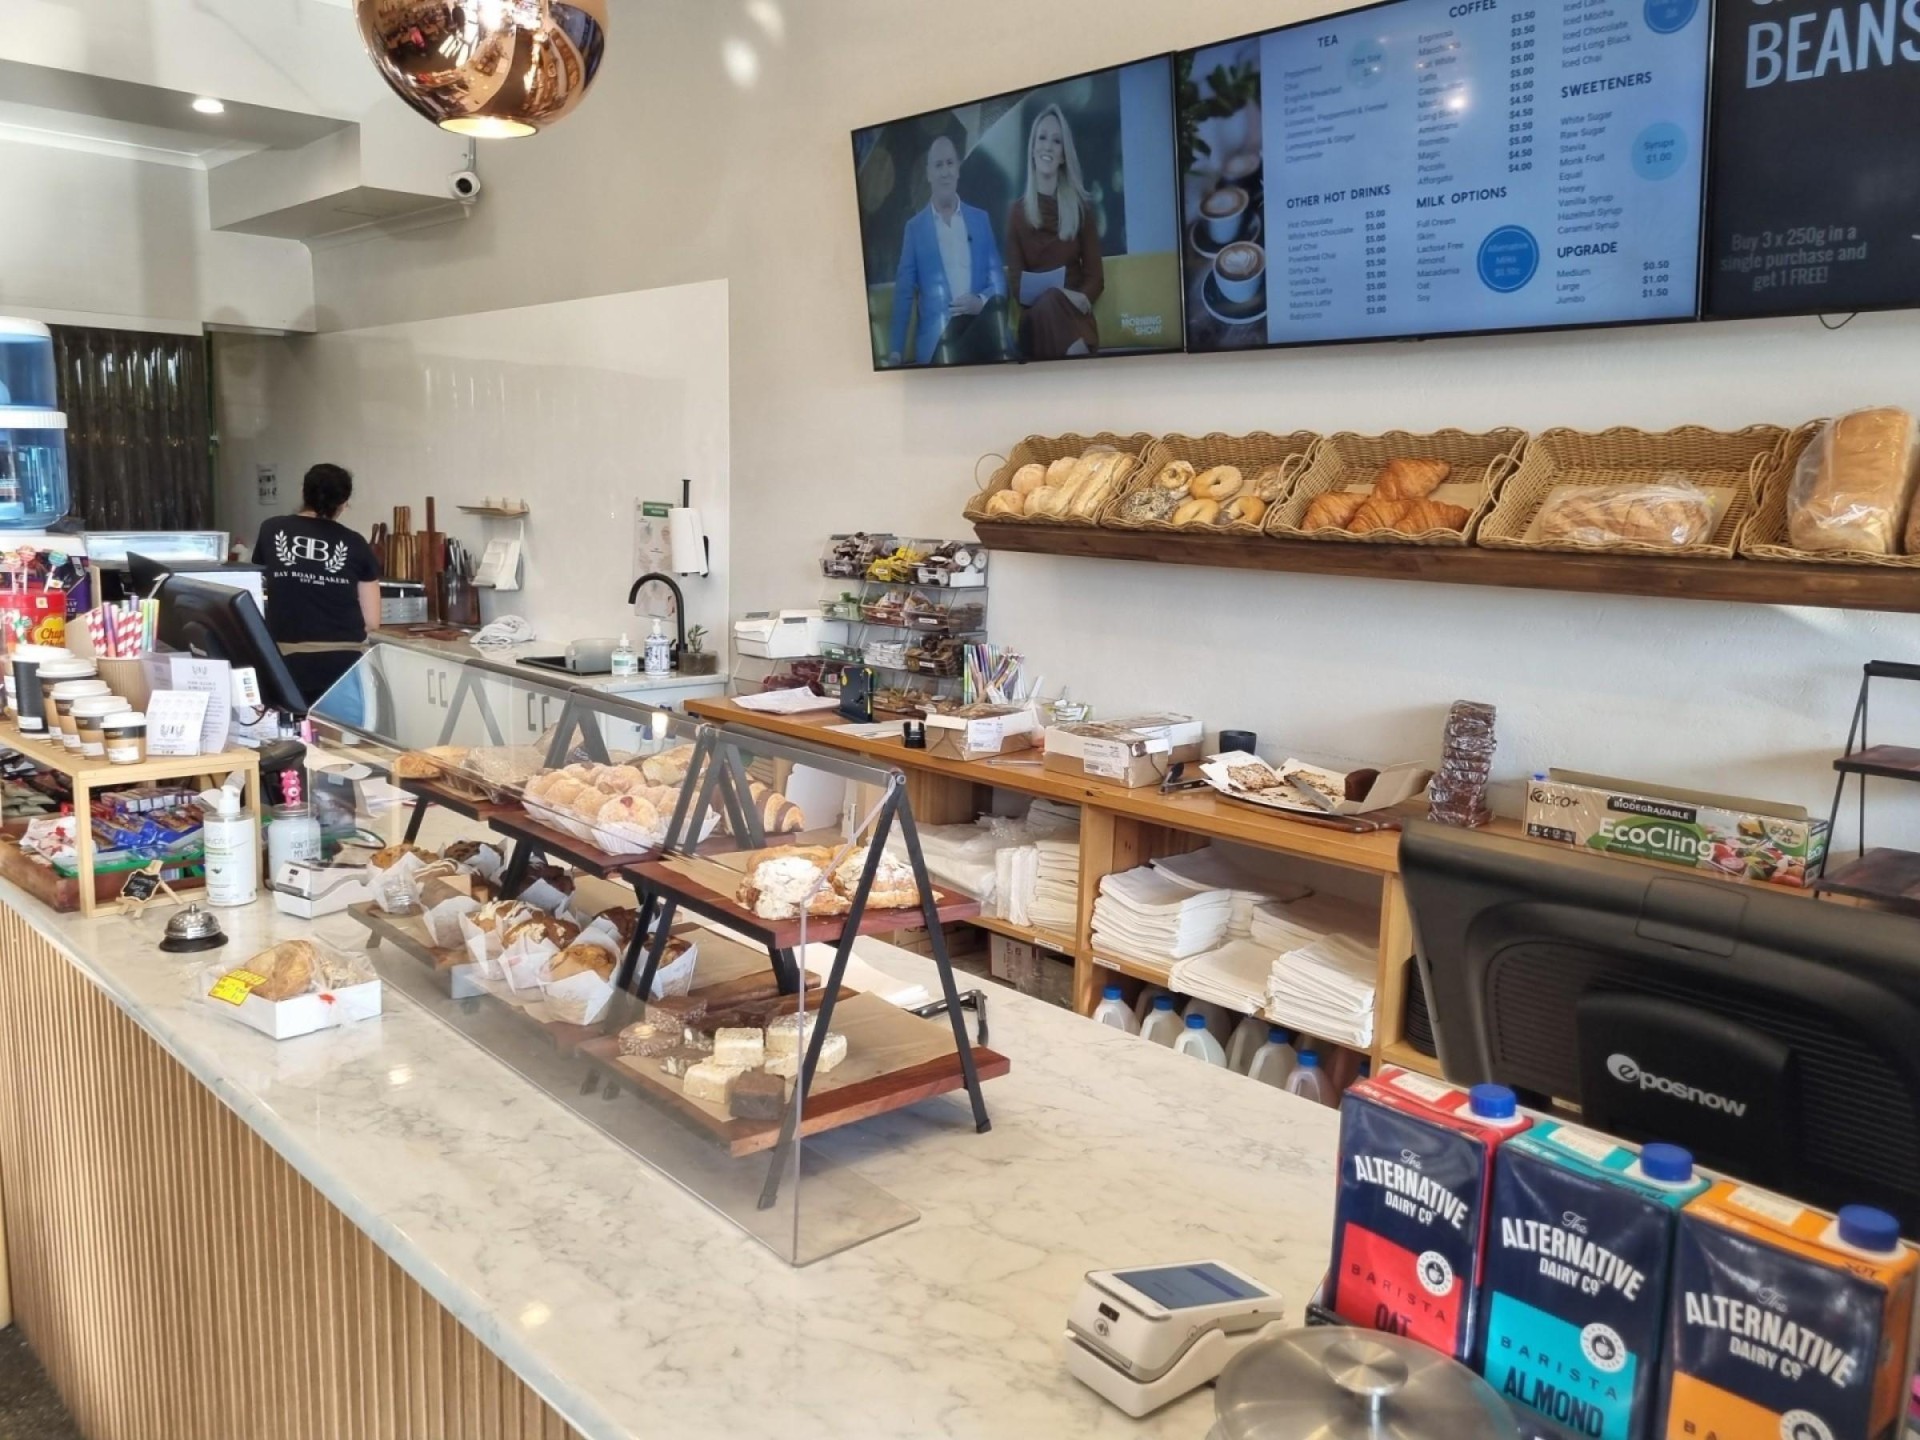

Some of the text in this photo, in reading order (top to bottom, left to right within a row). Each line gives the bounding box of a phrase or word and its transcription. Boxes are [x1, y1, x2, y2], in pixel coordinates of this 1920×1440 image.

[1449, 0, 1496, 18] COFFEE
[1511, 11, 1536, 24] $3.50
[1563, 16, 1582, 26] Iced
[1563, 20, 1628, 40] Iced Chocolate
[1511, 25, 1536, 38] $3.50
[1318, 35, 1338, 48] TEA
[1511, 40, 1535, 52] $5.00
[1562, 44, 1581, 54] Iced
[1510, 53, 1534, 65] $5.00
[1562, 58, 1580, 68] Iced
[1510, 67, 1534, 78] $5.00
[1510, 80, 1534, 92] $5.00
[1561, 72, 1653, 98] SWEETENERS
[1509, 94, 1534, 106] $4.50
[1508, 108, 1534, 120] $4.50
[1508, 122, 1533, 133] $3.50
[1508, 135, 1533, 146] $5.00
[1508, 148, 1532, 160] $4.50
[1508, 162, 1532, 173] $4.00
[1287, 184, 1391, 208] OTHER HOT DRINKS
[1416, 186, 1508, 209] MILK OPTIONS
[1732, 234, 1758, 252] Buy
[1762, 232, 1772, 248] 3
[1786, 226, 1826, 246] 250g
[1828, 225, 1844, 240] in
[1847, 226, 1857, 240] a
[1557, 242, 1618, 258] UPGRADE
[1721, 242, 1868, 273] single purchase and
[1642, 260, 1670, 272] $0.50
[1556, 274, 1669, 292] Large $1.00
[1752, 271, 1776, 292] get
[1789, 266, 1829, 286] FREE!
[1642, 288, 1668, 299] $1.50
[292, 572, 316, 580] ROAD
[1614, 800, 1690, 820] BIODEGRADABLE
[1598, 817, 1714, 862] EcoCling
[1354, 1154, 1468, 1230] ALTERNATIVE
[1384, 1190, 1417, 1220] DAIRY
[1562, 1210, 1588, 1235] The
[1500, 1216, 1645, 1301] ALTERNATIVE
[1540, 1256, 1579, 1288] DAIRY
[1350, 1262, 1447, 1323] BARISTA
[1376, 1303, 1412, 1339] OAT
[1685, 1291, 1858, 1388] ALTERNATIVE
[1729, 1336, 1778, 1370] DAIRY
[1500, 1335, 1618, 1401] BARISTA
[1504, 1366, 1604, 1439] ALMOND
